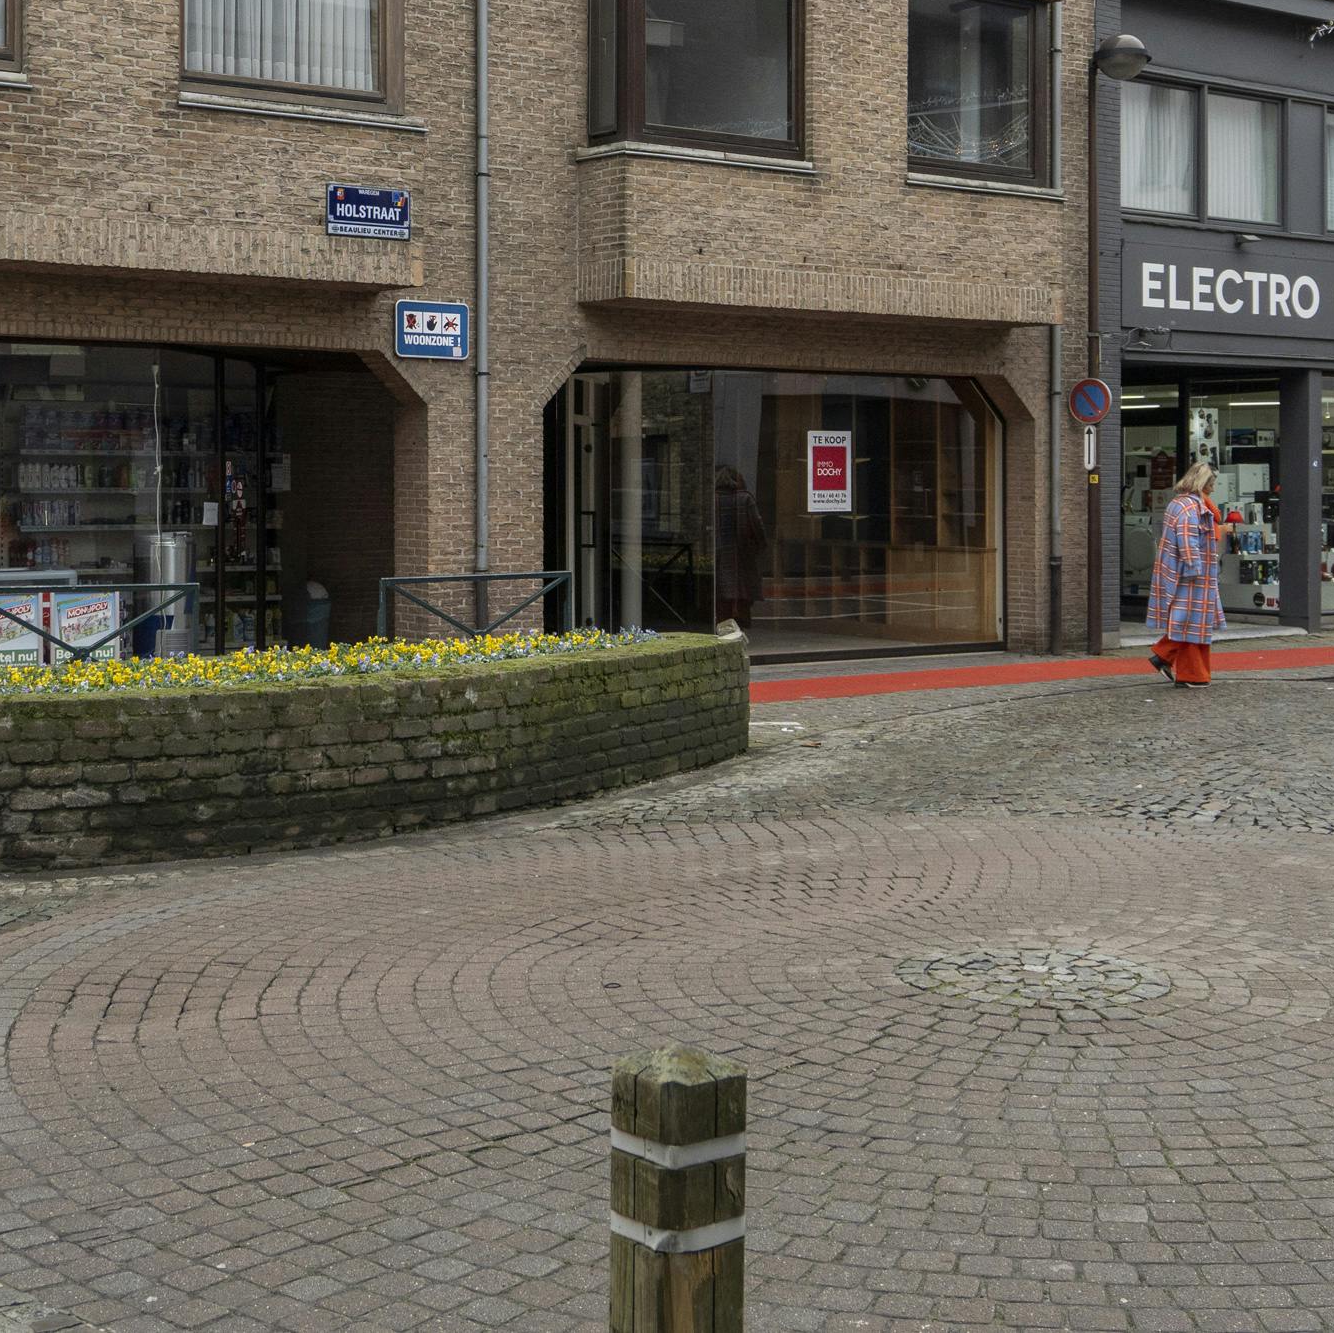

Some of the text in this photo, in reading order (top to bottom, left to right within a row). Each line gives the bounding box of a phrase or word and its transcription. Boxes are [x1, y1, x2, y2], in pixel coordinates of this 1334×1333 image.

[358, 189, 380, 197] WAREGEM
[336, 203, 401, 221] HOLSTRAAT
[340, 225, 398, 237] BEAULIEU CENTER
[1142, 262, 1320, 319] ELECTRO
[404, 334, 461, 347] WOONZONE !
[813, 436, 847, 444] TE KOOP
[817, 468, 842, 476] DOCHY
[19, 651, 37, 662] nu!
[96, 648, 114, 657] nu!
